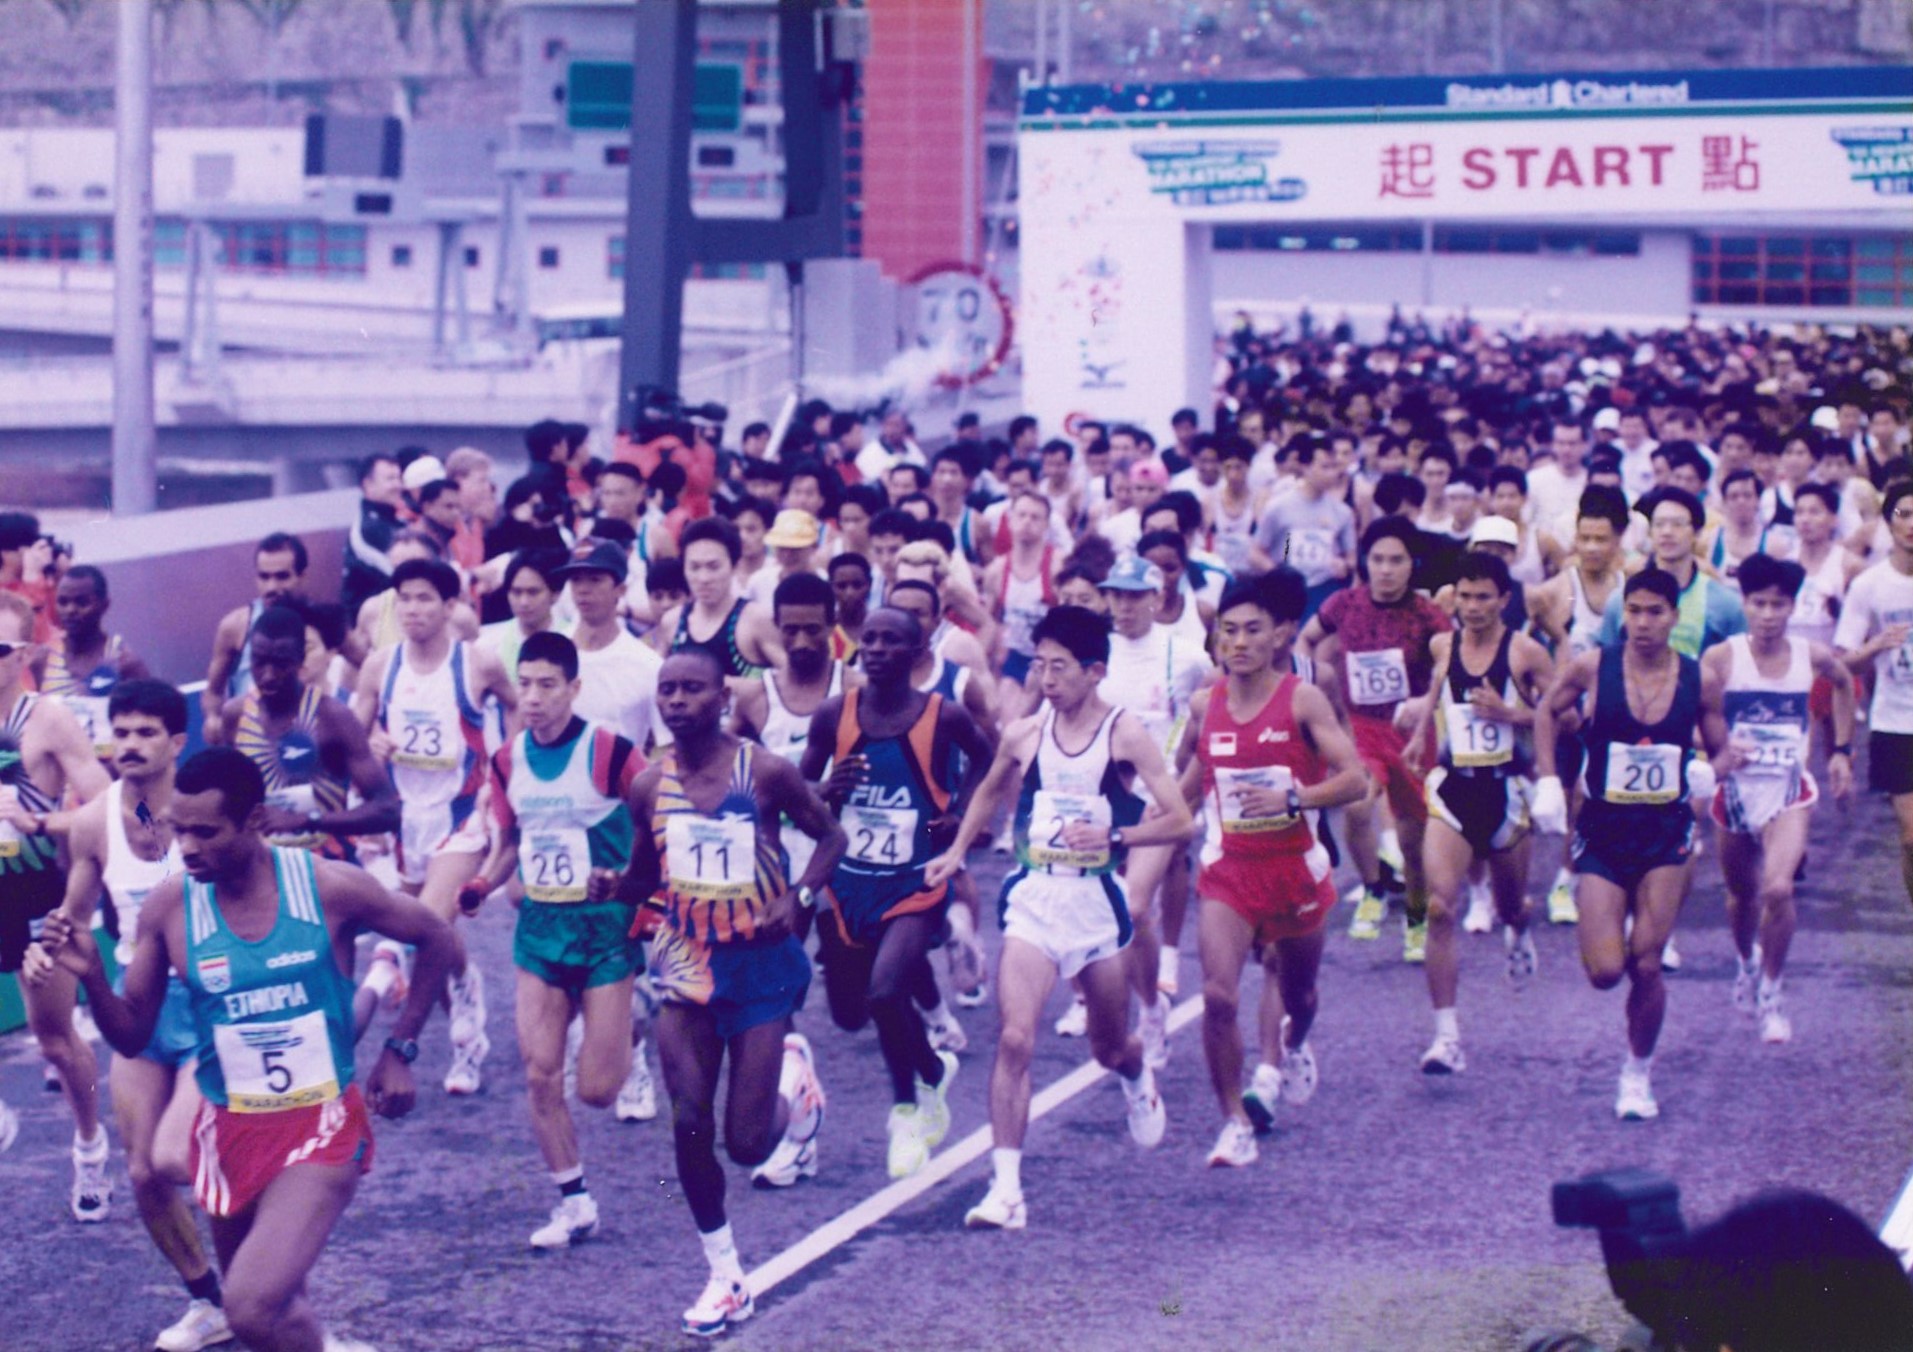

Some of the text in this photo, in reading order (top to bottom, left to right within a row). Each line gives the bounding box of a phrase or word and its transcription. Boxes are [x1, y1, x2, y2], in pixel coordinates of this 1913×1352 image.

[1446, 80, 1690, 108] Standard Chartered
[1379, 144, 1436, 198] 起
[1461, 145, 1674, 190] START
[1700, 135, 1760, 191] 點
[922, 287, 980, 323] 70
[1354, 667, 1403, 693] 169
[404, 725, 441, 756] 23
[1465, 723, 1499, 752] 19
[1624, 763, 1665, 791] 20
[849, 784, 912, 808] FILA
[689, 843, 729, 880] 11
[857, 828, 900, 865] 24
[531, 853, 574, 886] 26
[224, 981, 309, 1019] ETHIOPIA
[262, 1051, 292, 1093] 5
